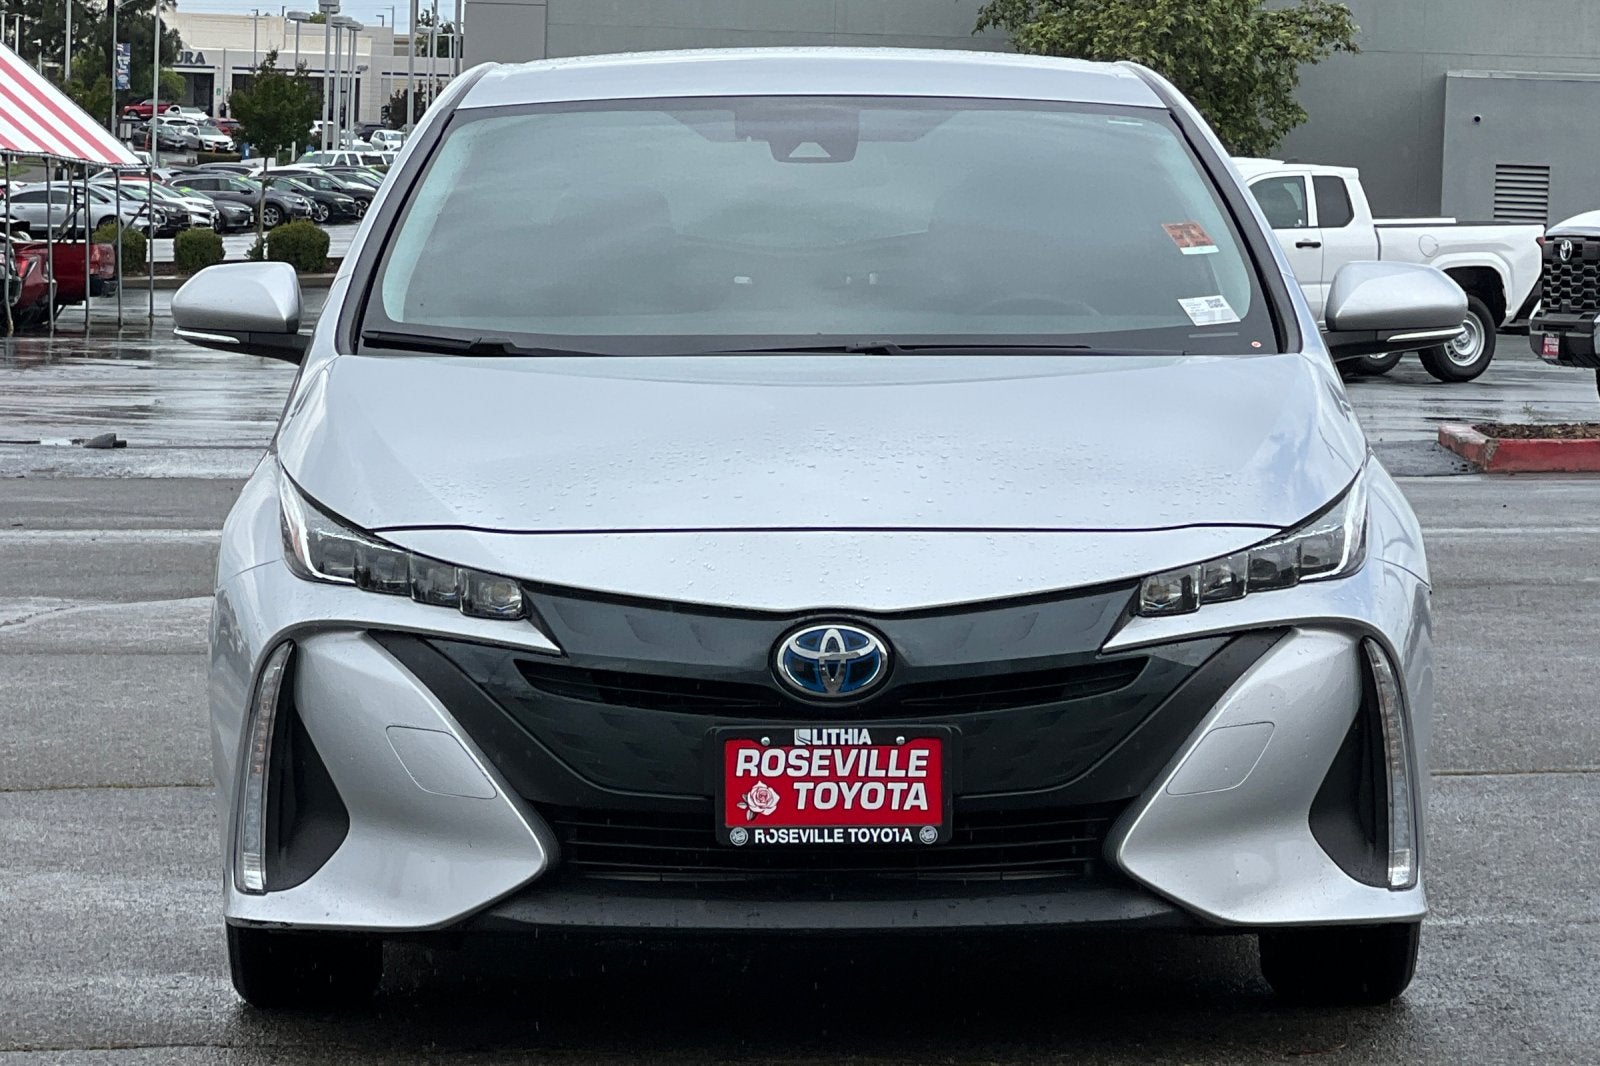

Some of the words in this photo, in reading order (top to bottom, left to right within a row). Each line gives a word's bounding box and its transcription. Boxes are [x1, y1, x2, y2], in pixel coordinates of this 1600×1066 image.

[174, 51, 206, 65] URA
[811, 728, 872, 745] LITHIA
[735, 748, 930, 778] ROSEVILLE
[793, 781, 929, 811] TOYOTA
